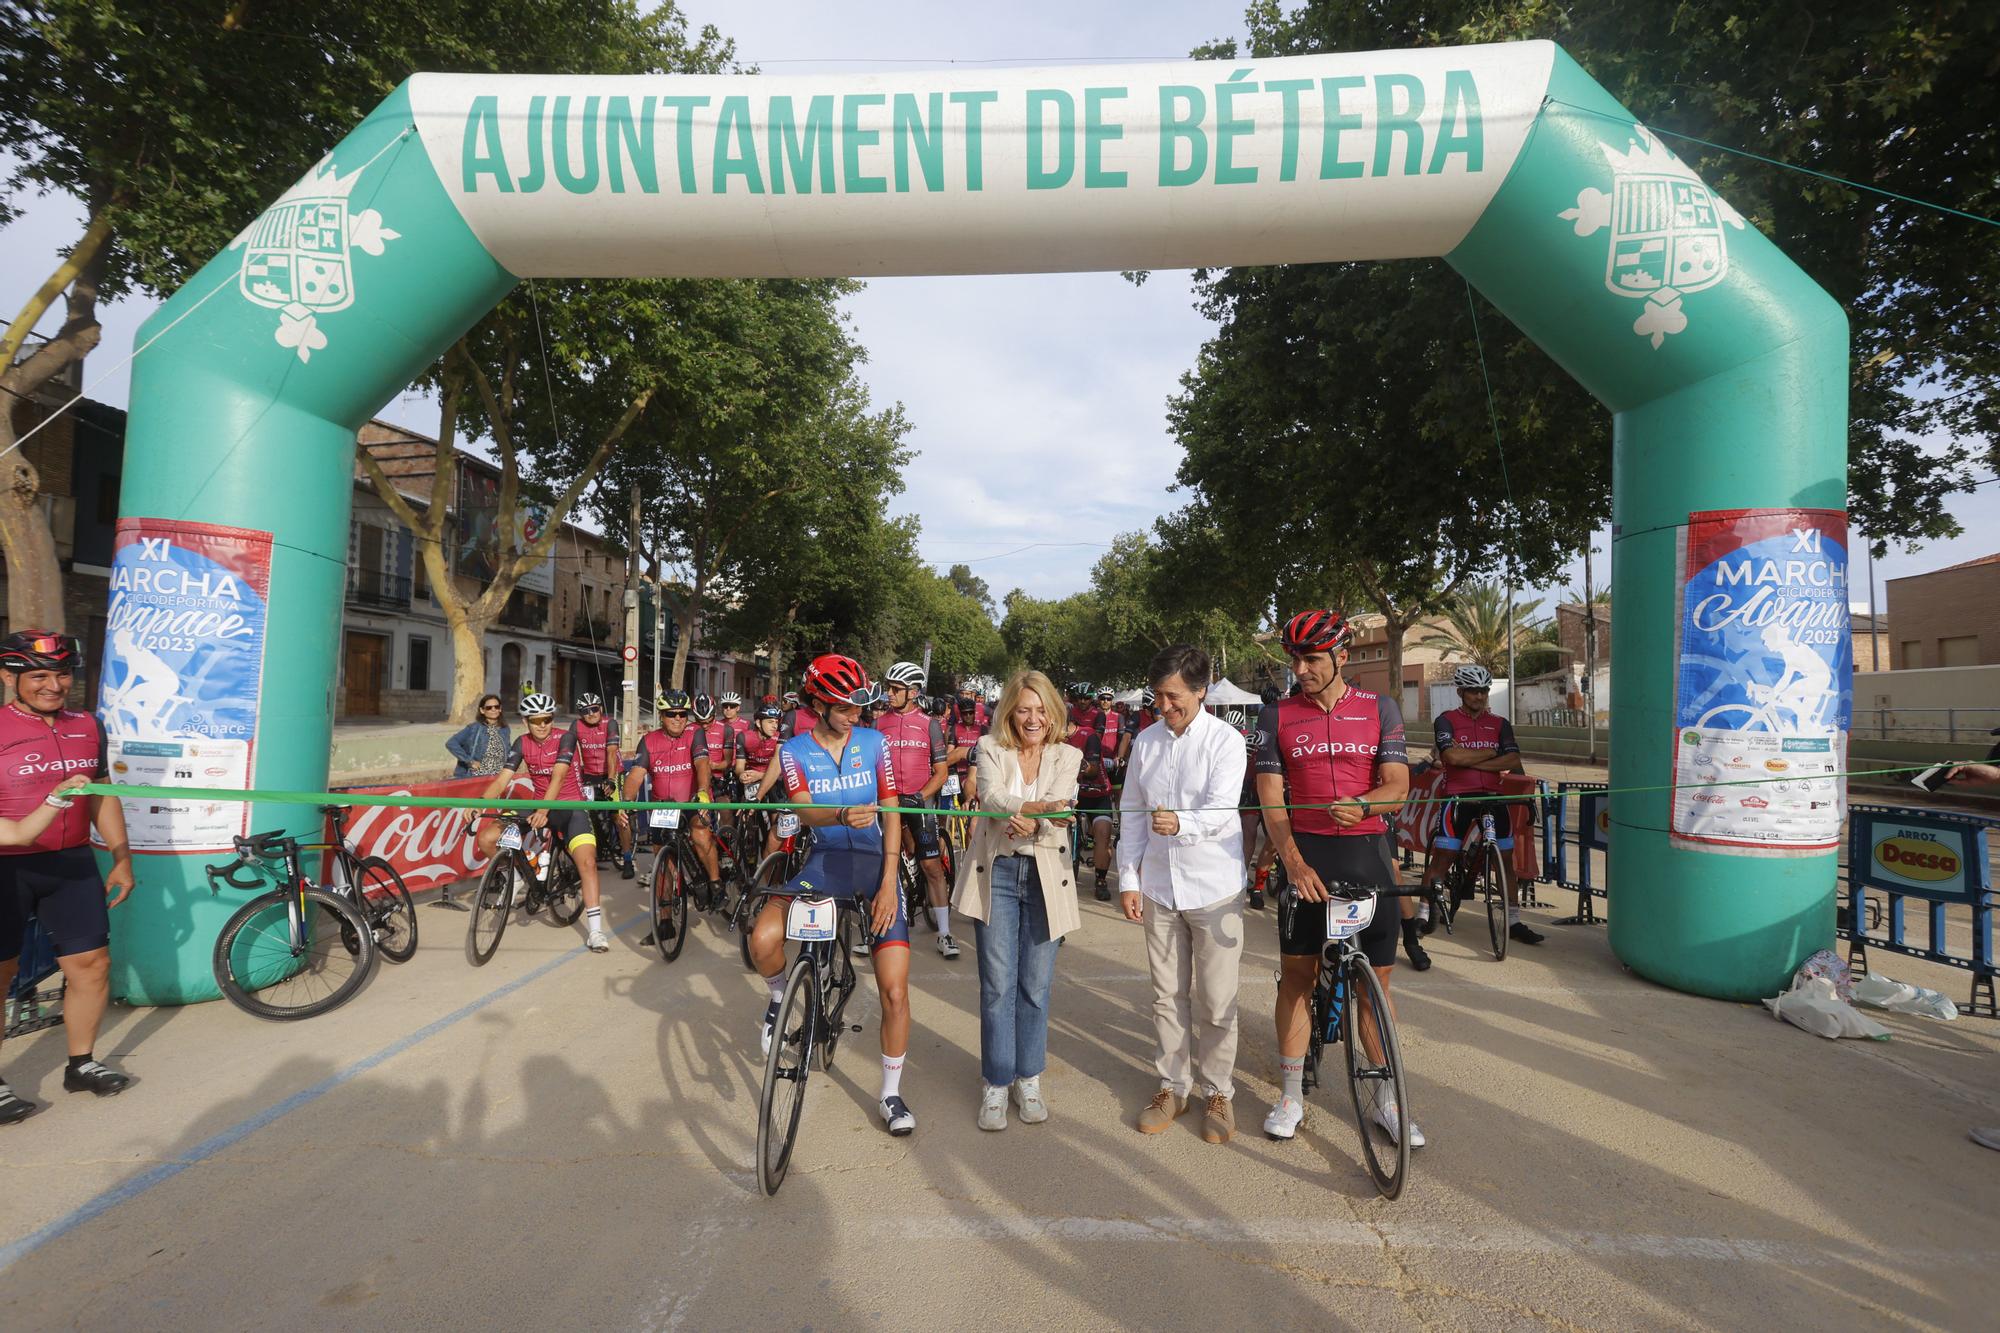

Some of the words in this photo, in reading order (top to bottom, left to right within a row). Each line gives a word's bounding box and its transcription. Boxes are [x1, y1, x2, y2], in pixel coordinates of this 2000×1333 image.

[462, 91, 998, 194] AJUNTAMENT
[1026, 87, 1128, 190] DE
[1158, 68, 1484, 187] BÉTERA
[138, 536, 171, 562] XI
[1791, 528, 1821, 553] XI
[125, 593, 239, 611] CICLODEPORTIVA
[146, 636, 196, 652] 2023
[1804, 629, 1839, 645] 2023
[183, 723, 246, 736] avapace
[1291, 742, 1378, 758] avapace
[18, 758, 99, 775] avapace
[653, 762, 692, 774] avapace
[783, 750, 800, 791] CERATIZIT
[881, 738, 896, 791] CERATIZIT
[808, 770, 872, 795] CERATIZIT
[1897, 829, 1937, 842] ARROZ
[1882, 843, 1957, 873] Dacsa
[807, 909, 816, 924] 1
[1347, 904, 1359, 919] 2
